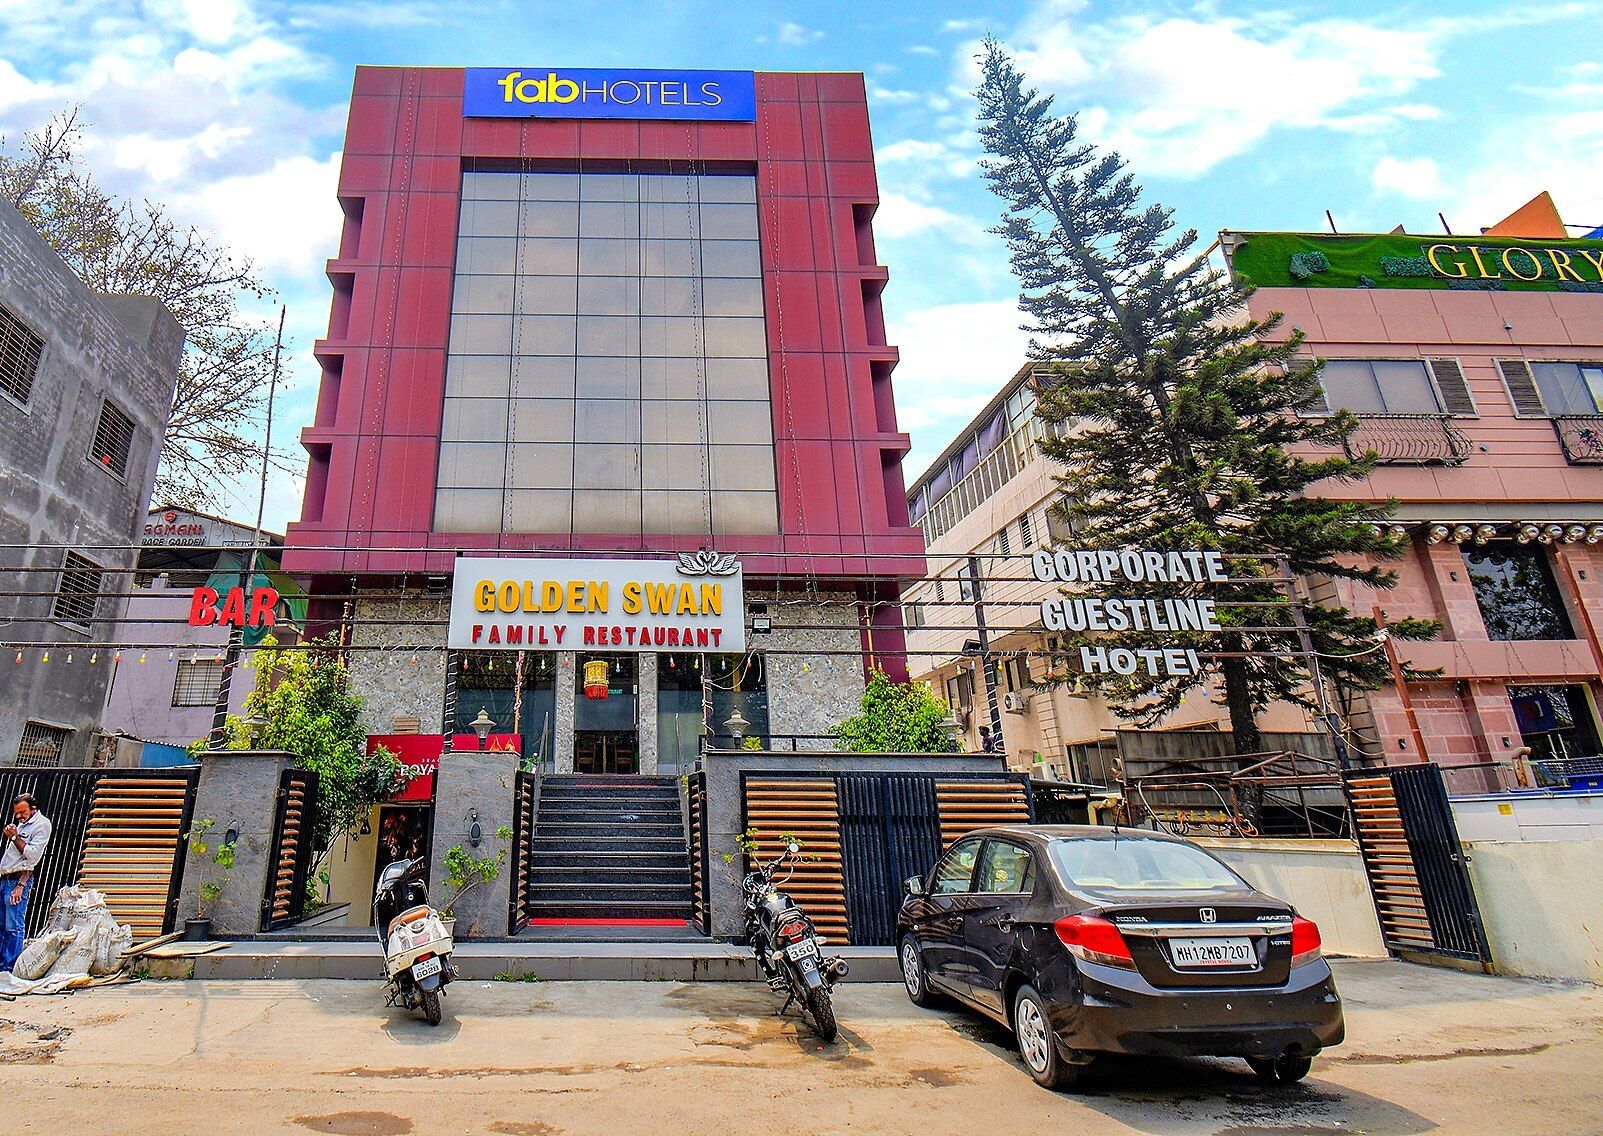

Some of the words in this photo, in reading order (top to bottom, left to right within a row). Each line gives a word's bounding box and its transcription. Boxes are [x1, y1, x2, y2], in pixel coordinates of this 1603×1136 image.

[168, 538, 205, 546] GARDEN
[1031, 550, 1229, 583] CORPORATE
[188, 587, 280, 627] BAR
[473, 579, 609, 615] GOLDEN
[621, 581, 724, 616] SWAN
[1040, 598, 1222, 632] GUESTLINE
[471, 624, 568, 645] FAMILY
[583, 625, 723, 648] RESTAURANT
[790, 944, 814, 959] 350
[1175, 945, 1250, 961] MH12MB7207
[416, 964, 440, 979] 6028
